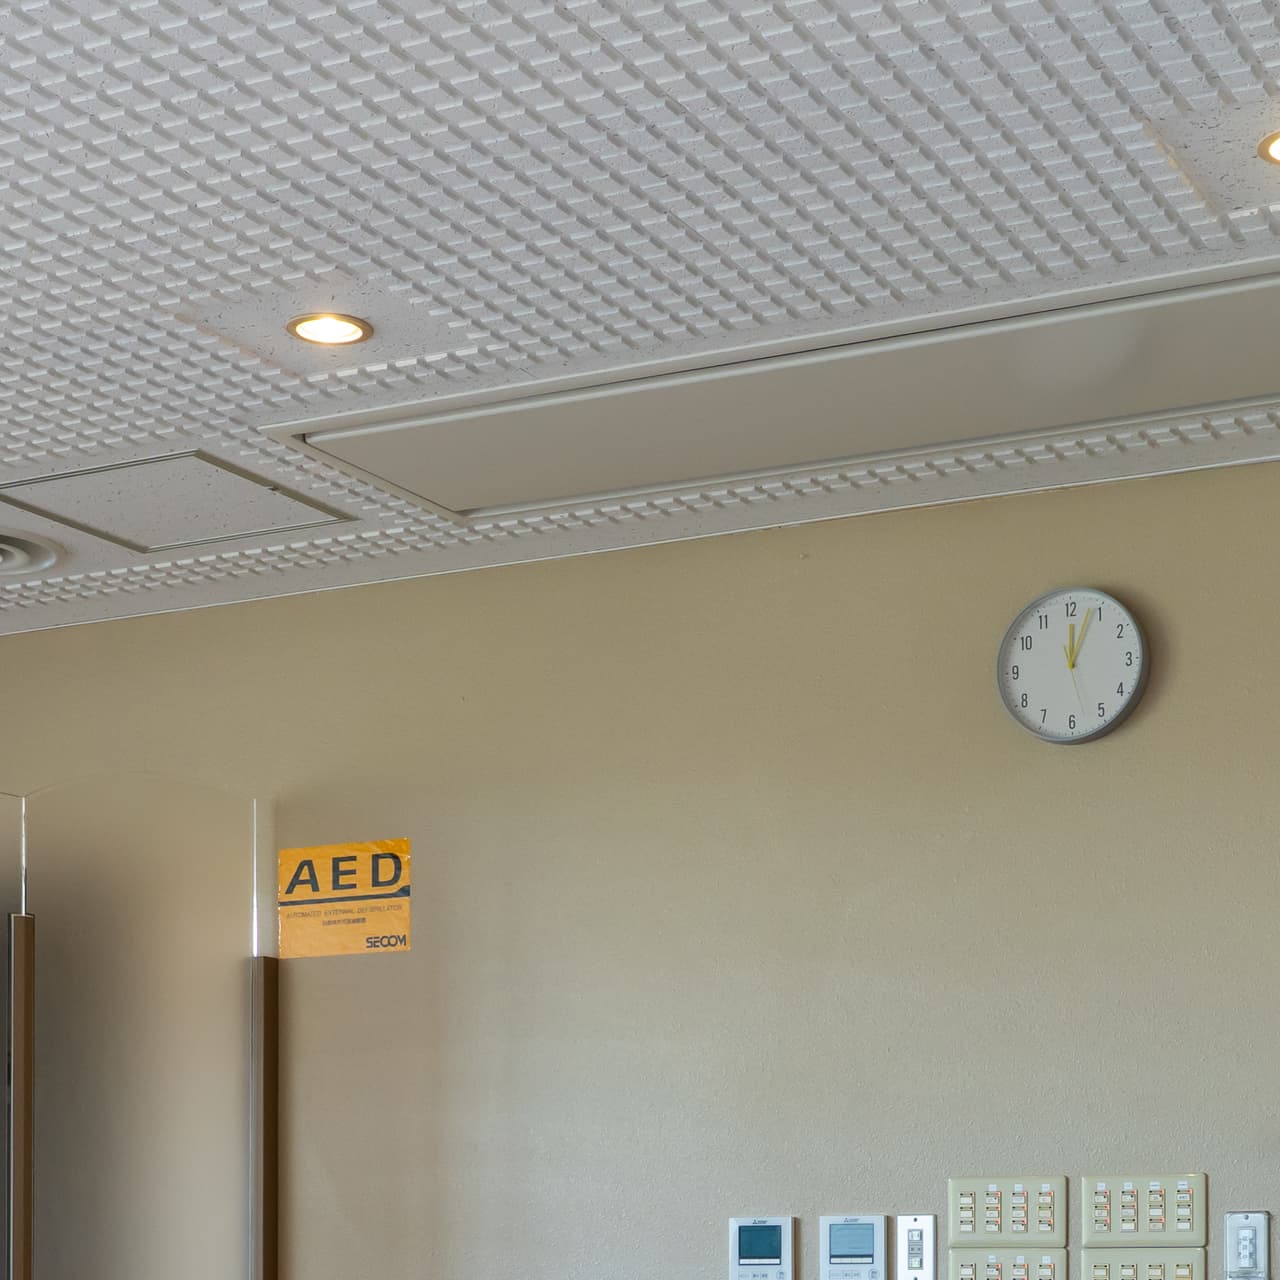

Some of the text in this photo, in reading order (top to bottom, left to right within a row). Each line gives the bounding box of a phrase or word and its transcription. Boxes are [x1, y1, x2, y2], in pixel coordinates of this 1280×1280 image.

[1065, 601, 1077, 618] 12
[1038, 614, 1049, 630] 11
[1116, 623, 1124, 639] 2
[1020, 635, 1033, 651] 10
[1125, 651, 1133, 667] 3
[1011, 665, 1020, 680] 9
[1116, 682, 1124, 697] 4
[1020, 693, 1029, 708] 8
[1039, 708, 1048, 724] 7
[1097, 702, 1106, 718] 5
[1068, 714, 1076, 730] 6
[284, 852, 402, 895] AED
[365, 934, 407, 949] SECOM
